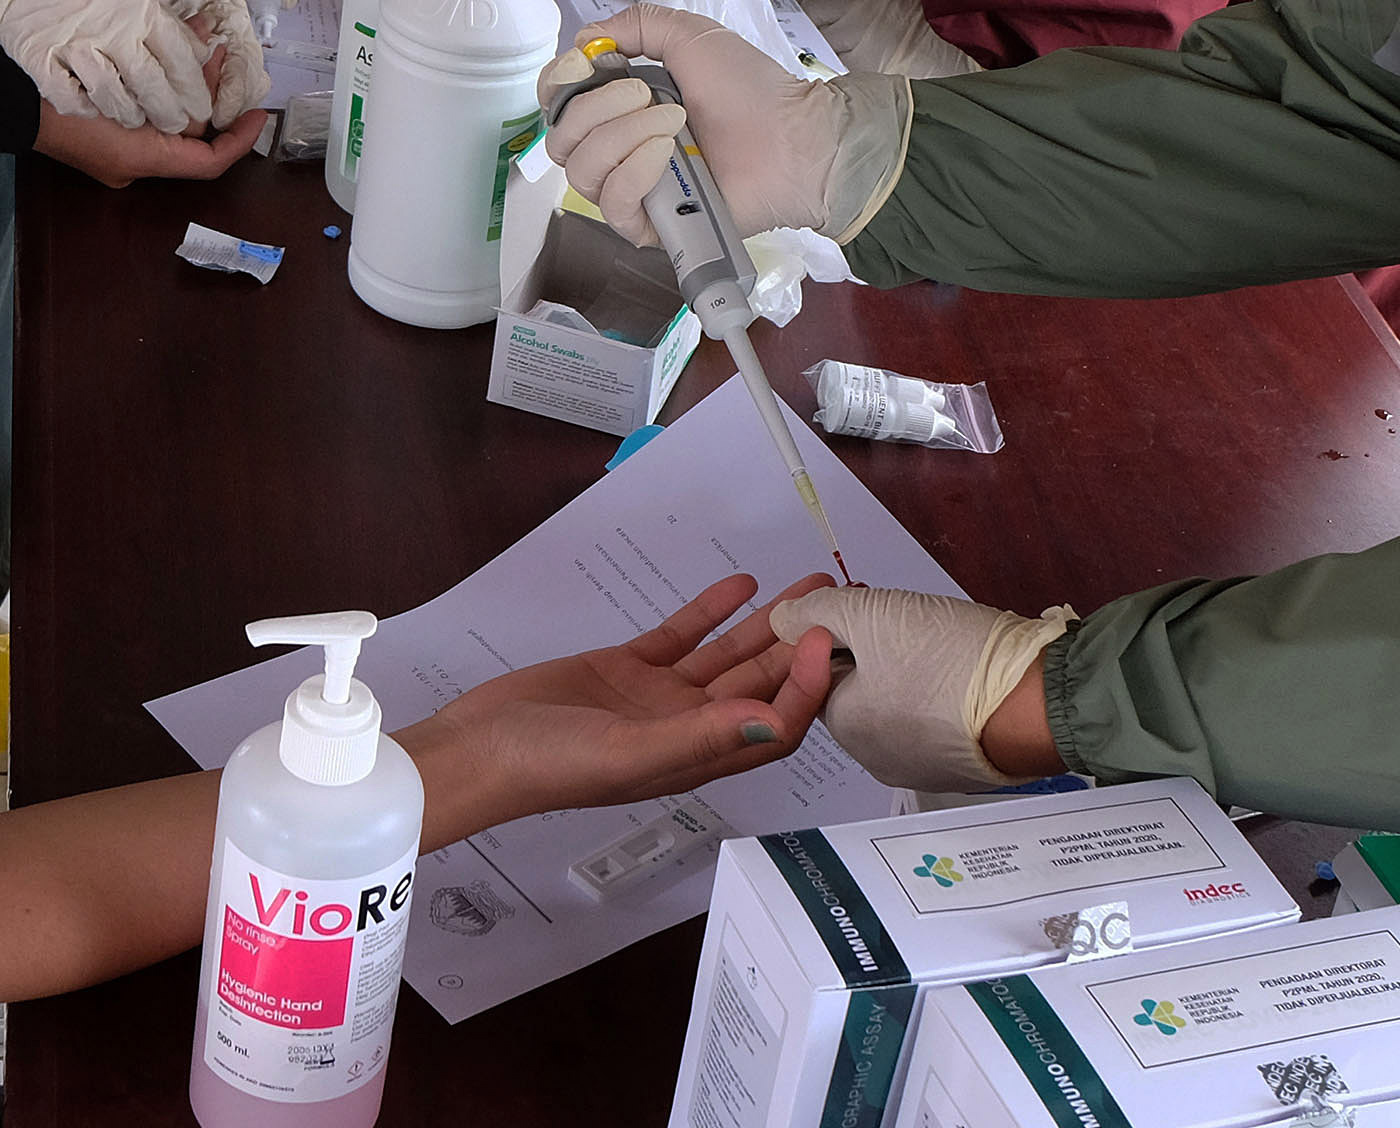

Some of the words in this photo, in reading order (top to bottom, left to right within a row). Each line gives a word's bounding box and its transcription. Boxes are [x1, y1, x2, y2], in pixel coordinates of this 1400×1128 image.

[711, 297, 726, 309] 100
[510, 332, 549, 350] Alcohol
[552, 345, 585, 361] Swabs
[1038, 829, 1102, 846] PENGADAAN
[1102, 822, 1165, 839] DIREKTORAT
[1096, 836, 1132, 850] TAHUN
[959, 844, 1020, 860] KEMENTERIAN
[962, 852, 1014, 865] KESEHATAN
[1050, 853, 1083, 868] TIDAK
[967, 860, 1009, 873] REPUBLIK
[971, 865, 1021, 880] INDONESIA
[1184, 881, 1246, 902] indec
[227, 911, 243, 931] No
[225, 925, 260, 956] Spray
[1071, 913, 1131, 956] QC
[1259, 970, 1324, 989] PENGADAAN
[1323, 958, 1386, 976] DIREKTORAT
[221, 968, 277, 1006] Hygienic
[280, 996, 323, 1012] Hand
[1177, 987, 1240, 1003] KEMENTERIAN
[1281, 983, 1319, 998] P2PML
[1320, 977, 1355, 991] TAHUN
[220, 983, 302, 1025] Desinfection
[1183, 996, 1234, 1010] KESEHATAN
[1189, 1005, 1231, 1018] REPUBLIK
[1273, 1001, 1305, 1013] TIDAK
[1194, 1010, 1244, 1025] INDONESIA
[861, 1002, 887, 1055] ASSAY
[216, 1030, 233, 1048] 500
